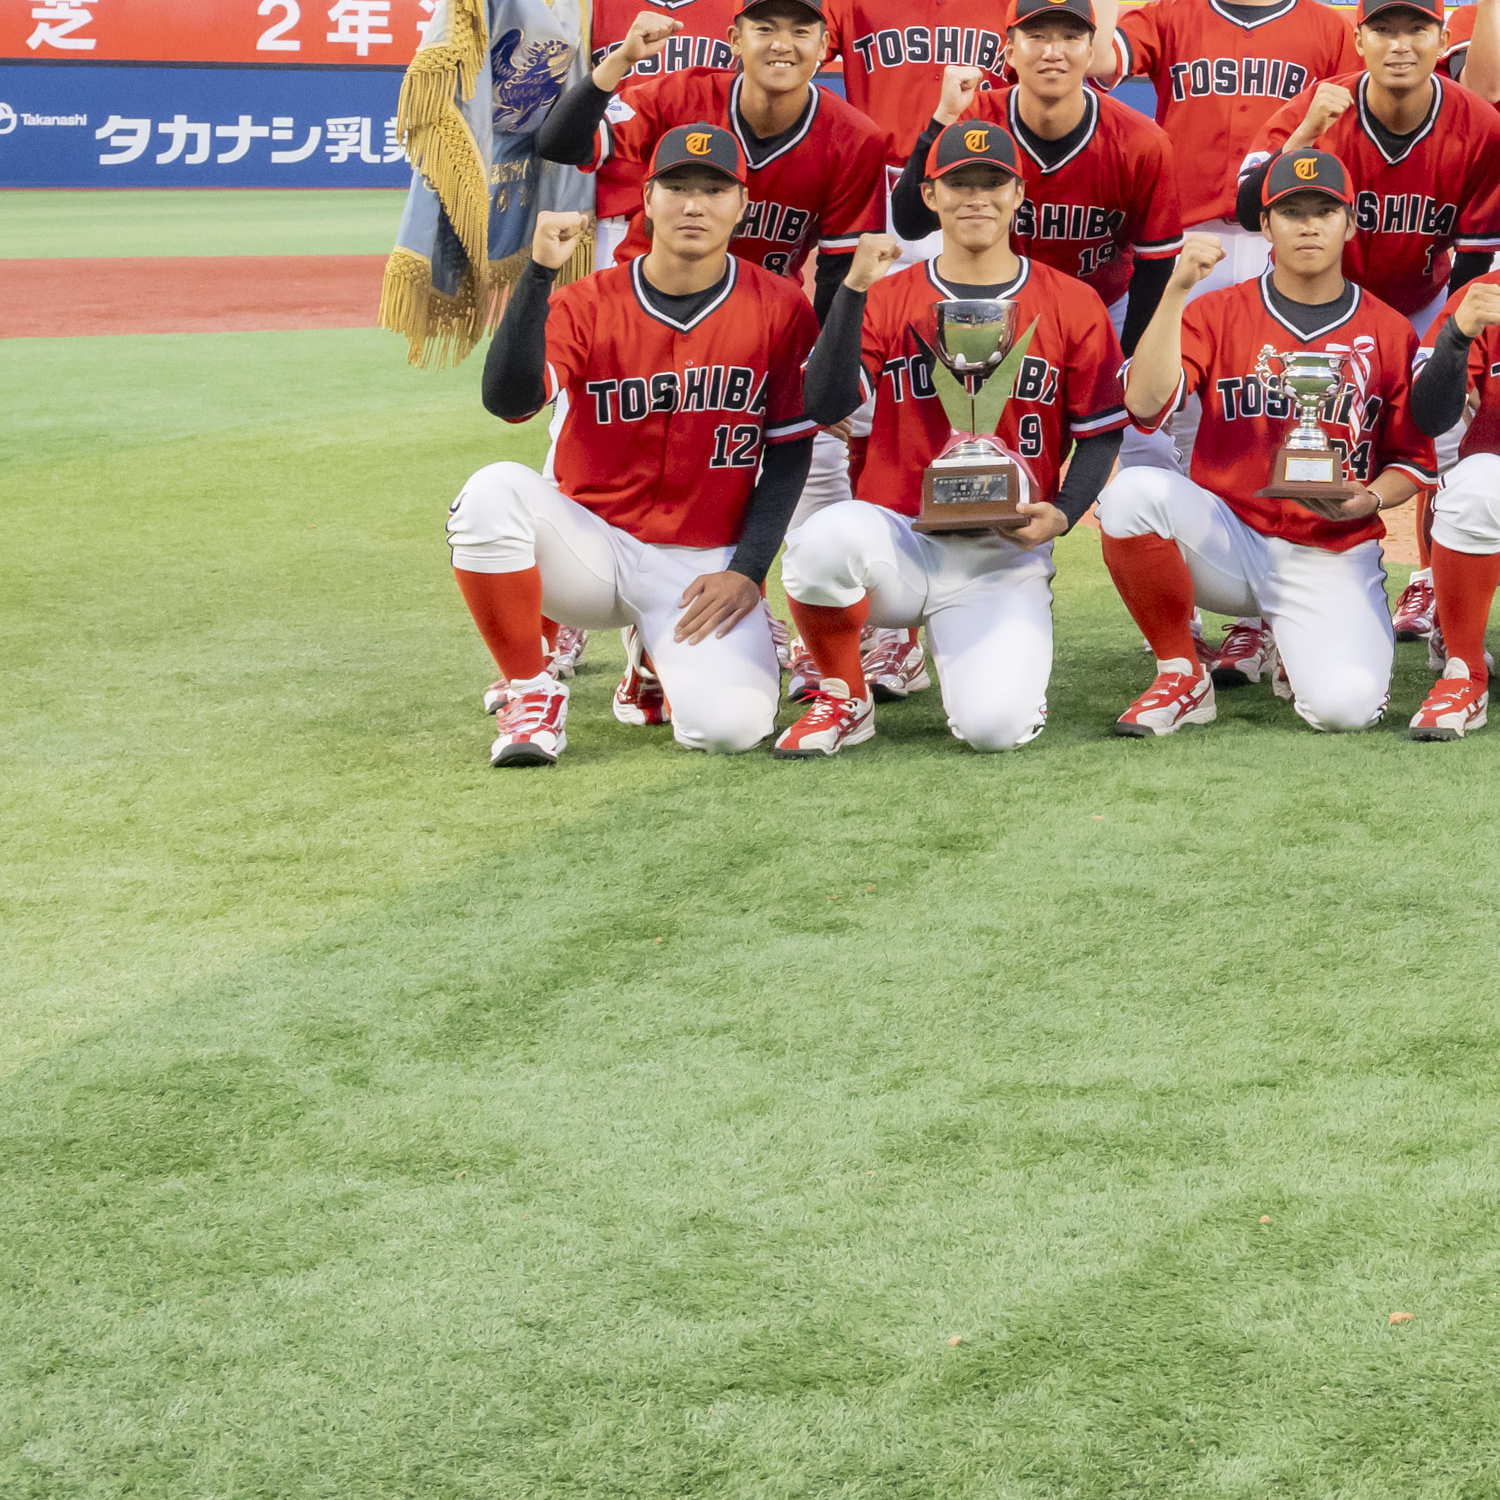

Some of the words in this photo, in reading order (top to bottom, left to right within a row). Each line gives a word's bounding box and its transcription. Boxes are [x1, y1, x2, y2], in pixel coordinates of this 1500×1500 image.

[1170, 57, 1317, 102] TOSHIB
[20, 113, 87, 127] Takanashi
[586, 365, 767, 425] TOSHIBA
[710, 424, 760, 468] 12
[1018, 413, 1041, 458] 9
